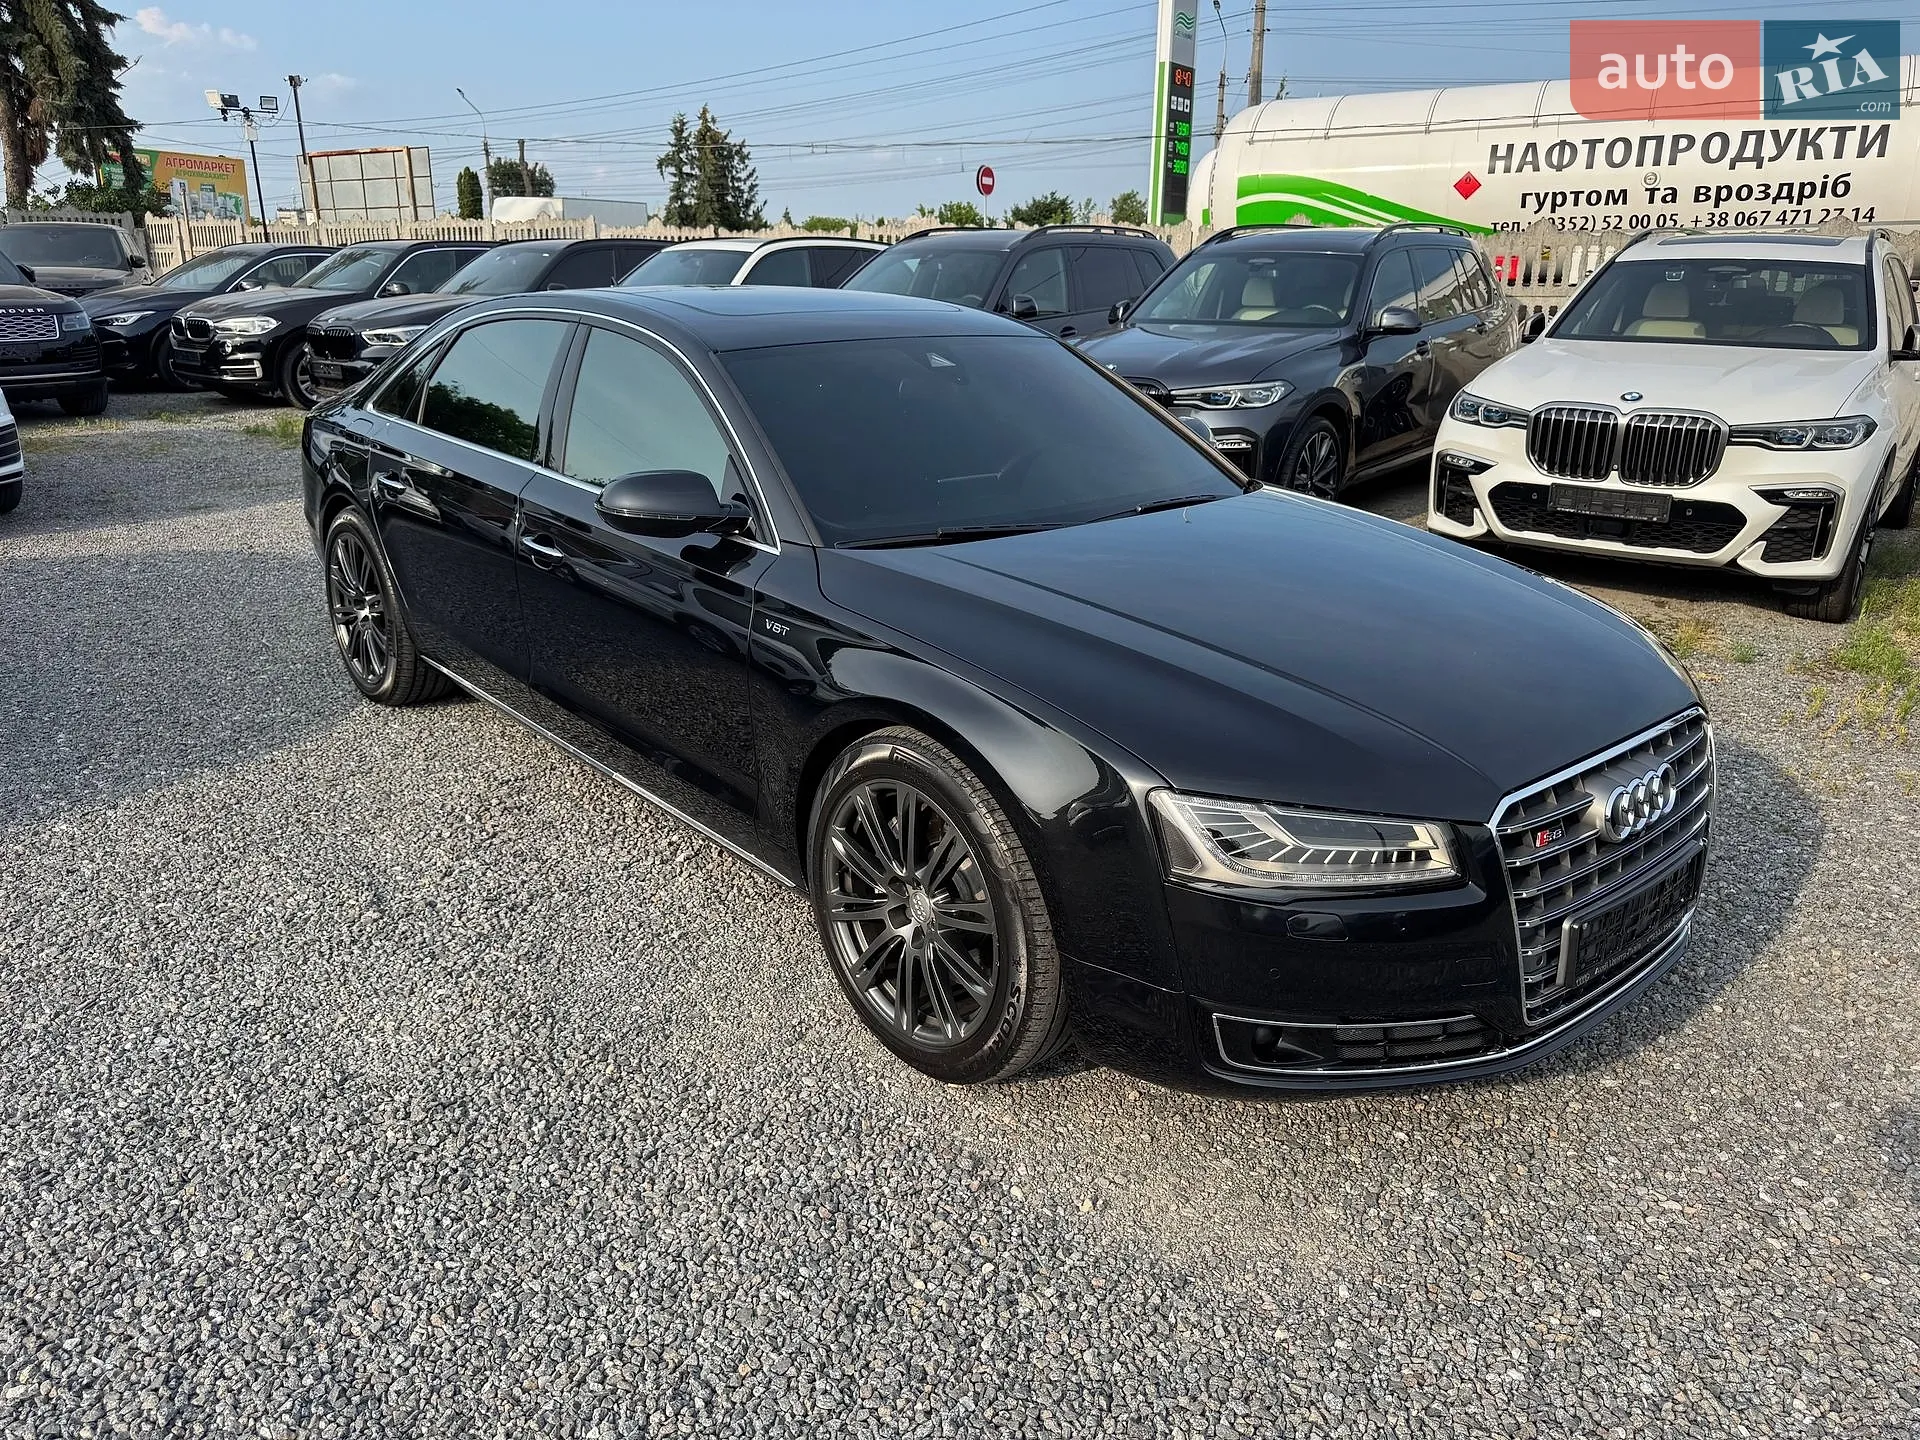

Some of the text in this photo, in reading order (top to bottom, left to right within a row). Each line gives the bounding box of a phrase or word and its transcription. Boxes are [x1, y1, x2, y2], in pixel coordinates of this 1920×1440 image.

[1487, 124, 1892, 175] НАФТОПРОДУКТИ
[165, 157, 236, 173] АГРОМАРКЕТ
[1520, 173, 1853, 214] гуртом та вроздріб
[1601, 215, 1624, 231] 52
[1629, 214, 1651, 229] 00
[1690, 211, 1729, 228] +38
[1733, 210, 1771, 227] 067
[1775, 209, 1812, 226] 471
[1851, 206, 1876, 223] 14
[765, 618, 790, 636] V8T
